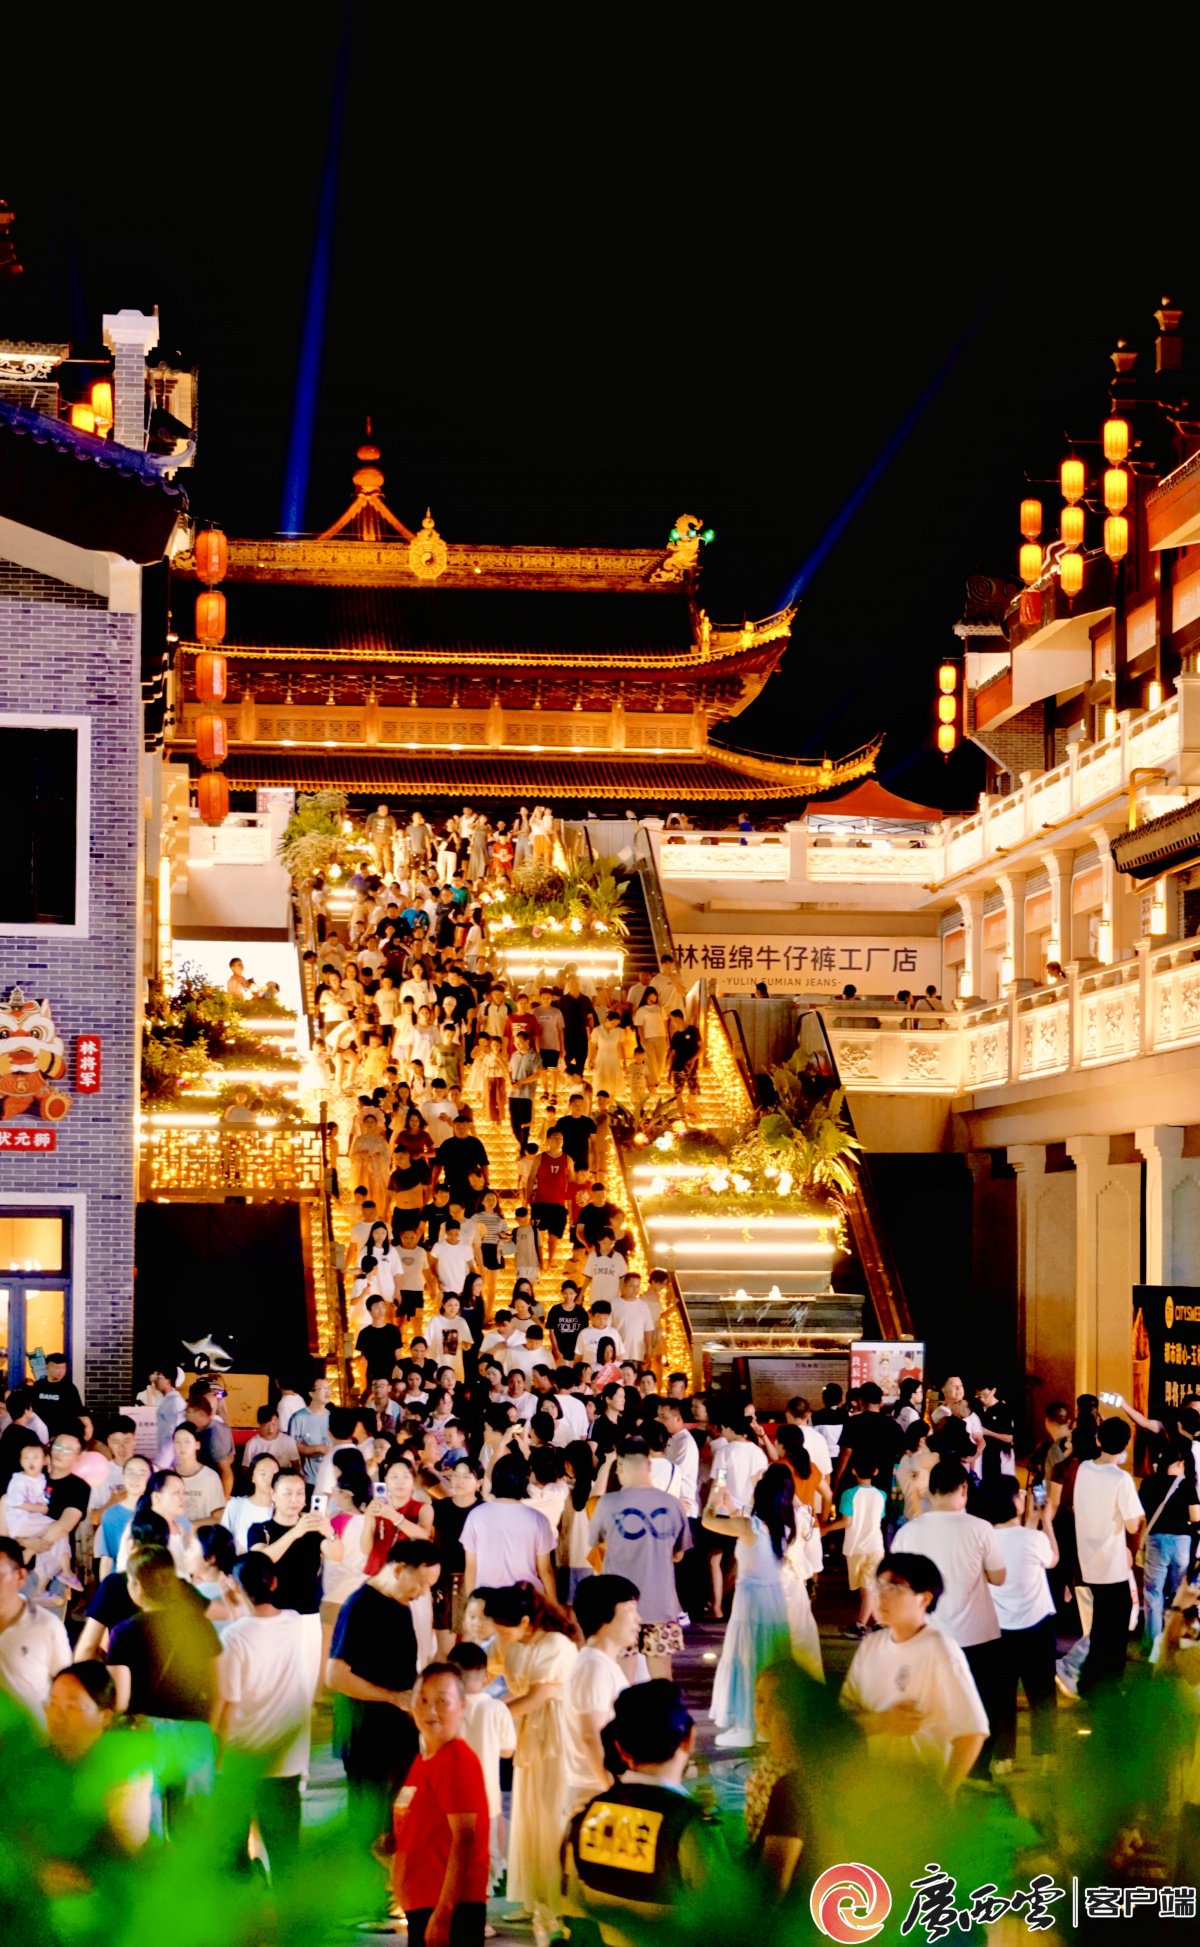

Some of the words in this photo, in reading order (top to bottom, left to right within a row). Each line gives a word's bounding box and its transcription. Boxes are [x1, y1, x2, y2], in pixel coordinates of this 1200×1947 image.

[79, 1040, 98, 1087] 林将军
[550, 1165, 560, 1174] 17
